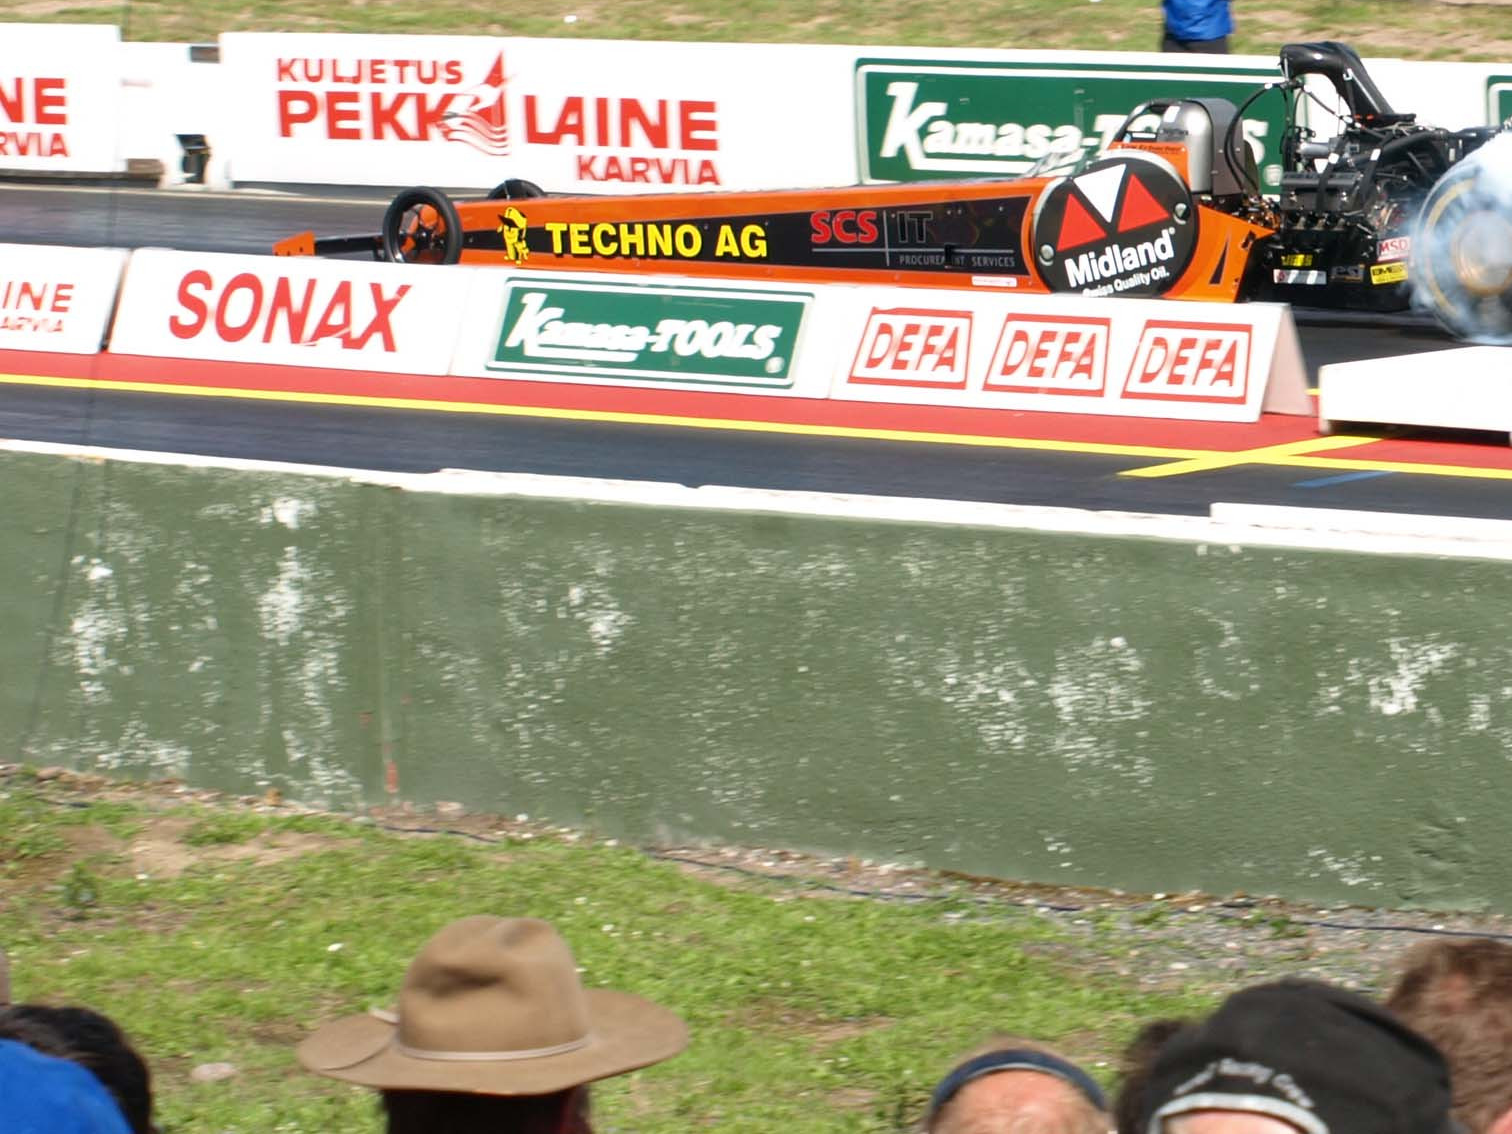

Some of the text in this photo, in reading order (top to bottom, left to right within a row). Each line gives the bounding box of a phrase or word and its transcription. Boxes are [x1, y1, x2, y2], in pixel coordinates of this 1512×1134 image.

[277, 57, 463, 85] KULJETUS
[524, 94, 719, 151] LAINE
[577, 154, 721, 185] KARVIA
[545, 222, 767, 258] TECHNO AG
[811, 210, 934, 243] SCS IT
[900, 254, 1015, 267] PROCURENT SERVICES
[1064, 229, 1174, 288] Midland
[1113, 272, 1151, 291] Quality
[169, 270, 412, 352] SONAX
[865, 322, 1240, 387] DEFA DEFA DEFA
